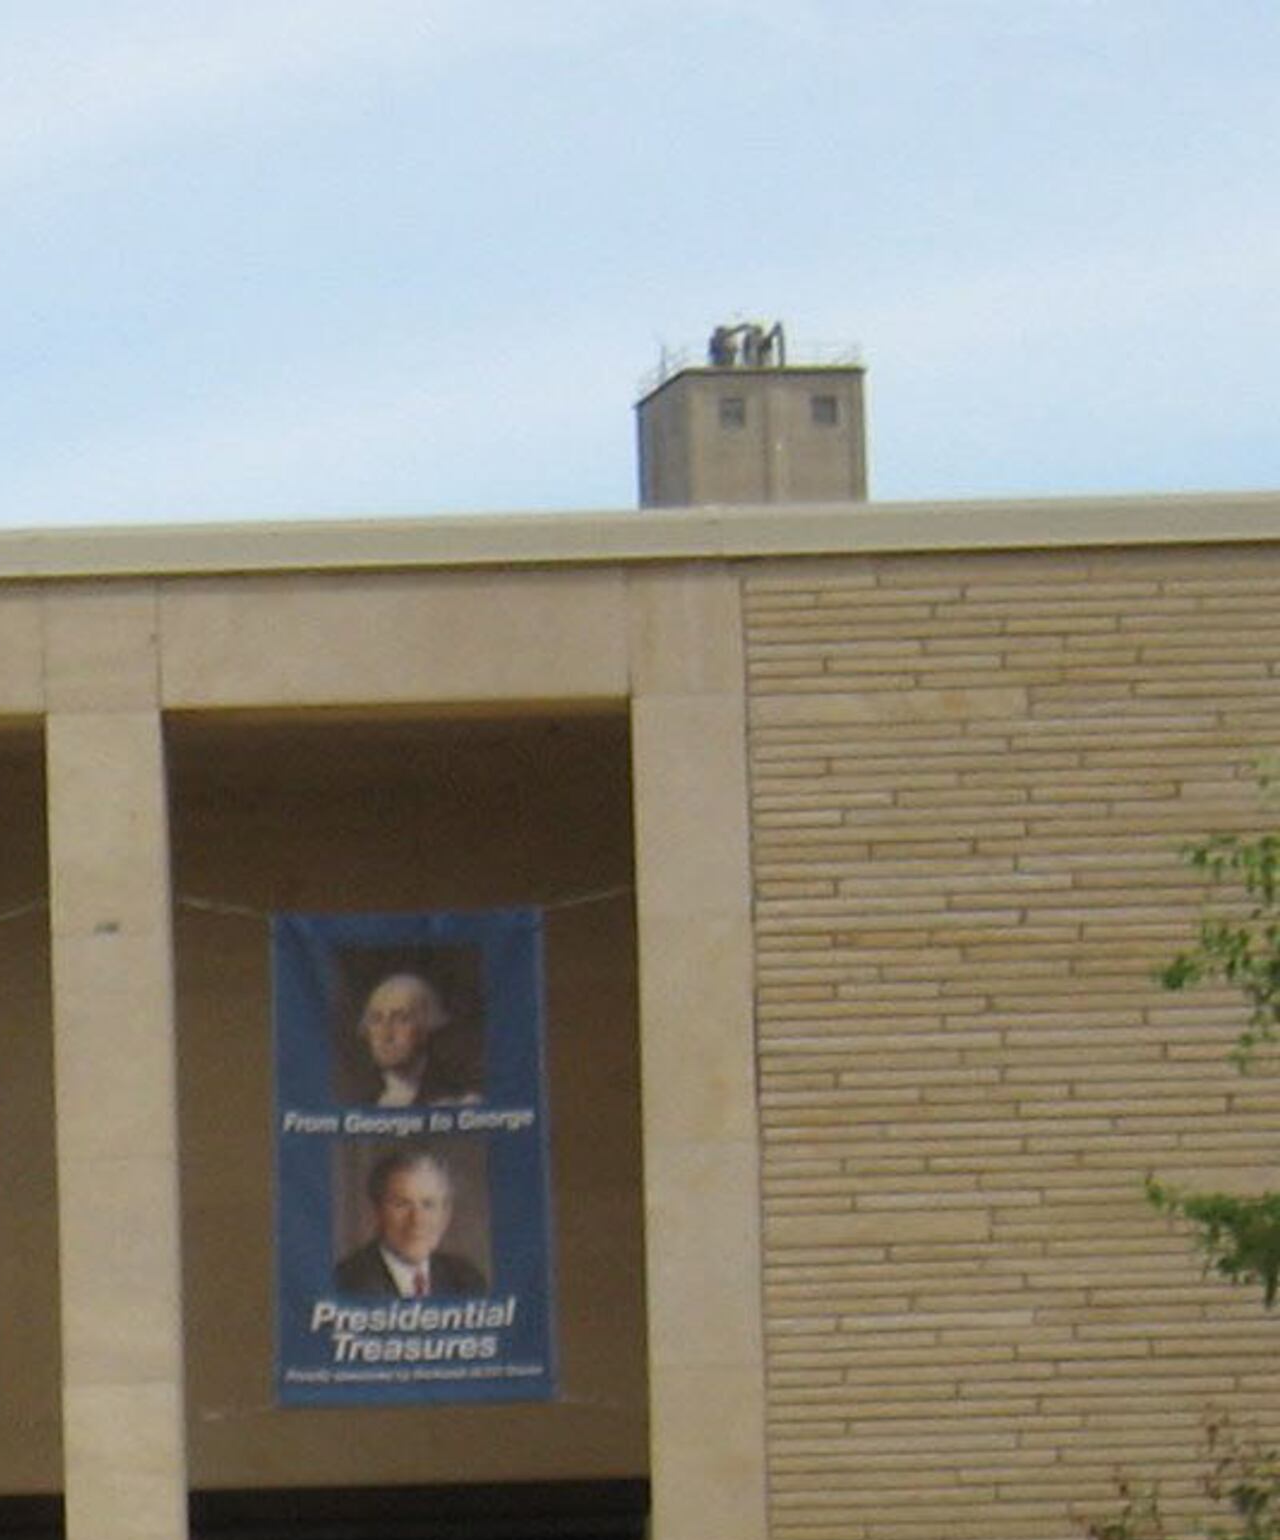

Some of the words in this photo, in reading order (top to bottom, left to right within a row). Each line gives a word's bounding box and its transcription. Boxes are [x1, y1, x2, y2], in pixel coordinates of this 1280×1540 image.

[283, 1111, 339, 1133] From
[344, 1112, 423, 1135] George
[429, 1112, 452, 1131] to
[459, 1108, 535, 1131] George
[310, 1297, 516, 1333] Presidential
[330, 1333, 497, 1363] Treasures
